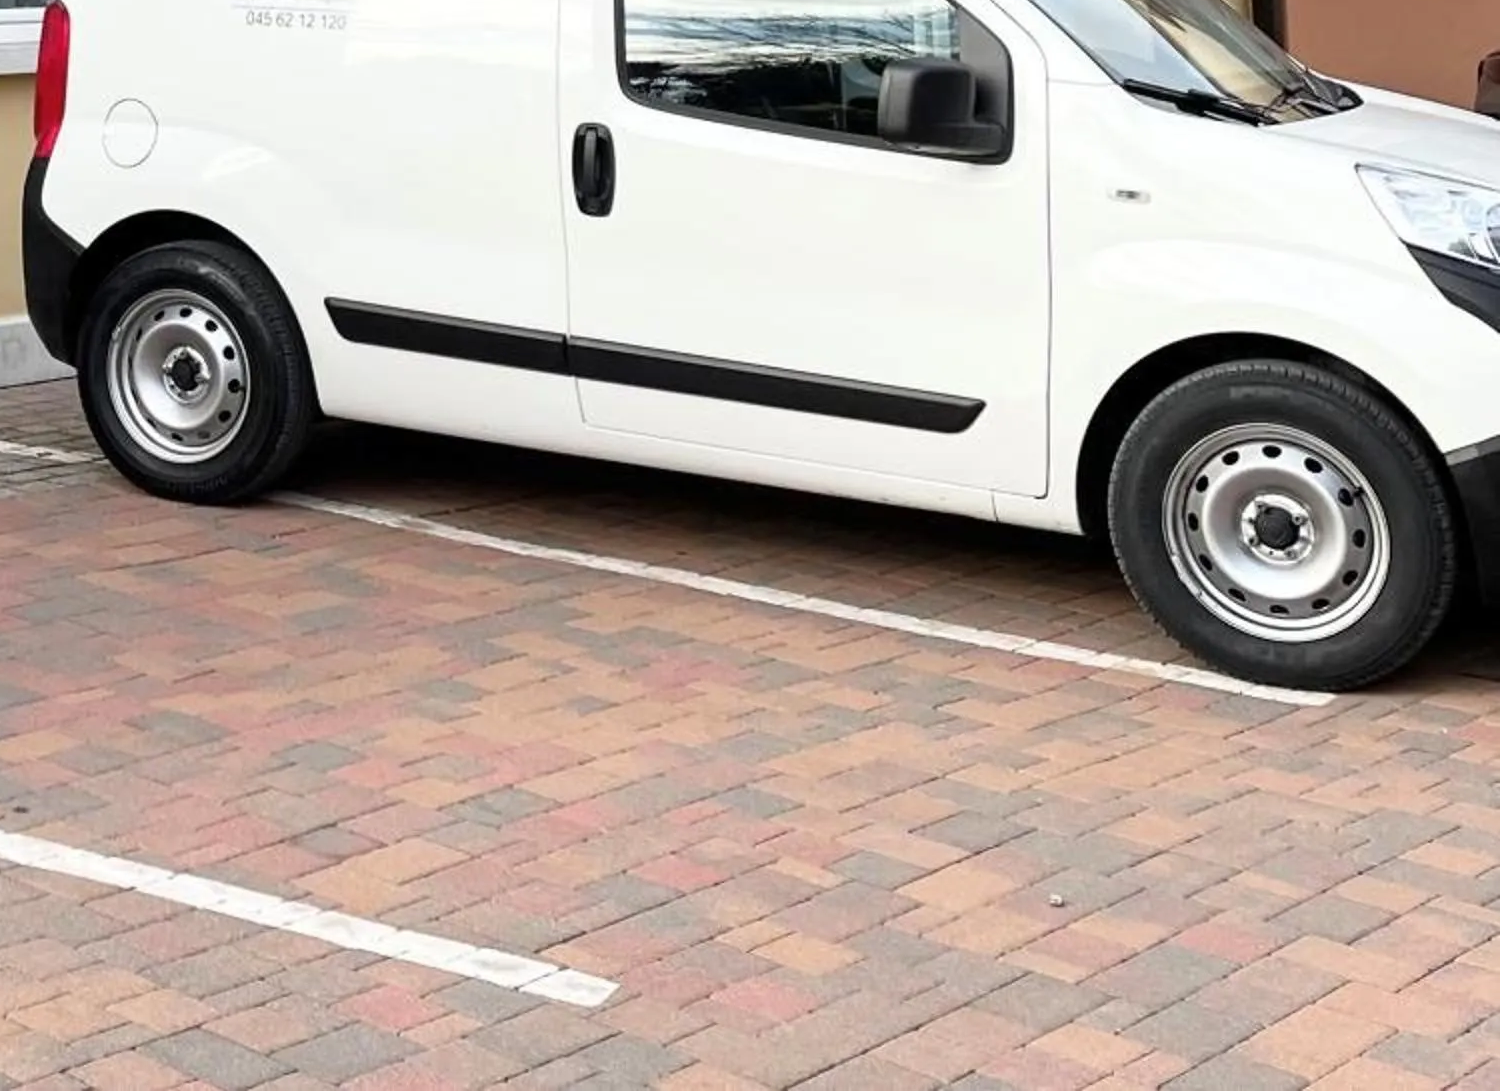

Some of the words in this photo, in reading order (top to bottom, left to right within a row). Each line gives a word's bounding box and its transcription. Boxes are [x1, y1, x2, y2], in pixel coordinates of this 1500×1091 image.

[245, 10, 273, 27] 045
[275, 12, 294, 28] 62
[299, 13, 316, 30] 12
[321, 14, 347, 31] 120
